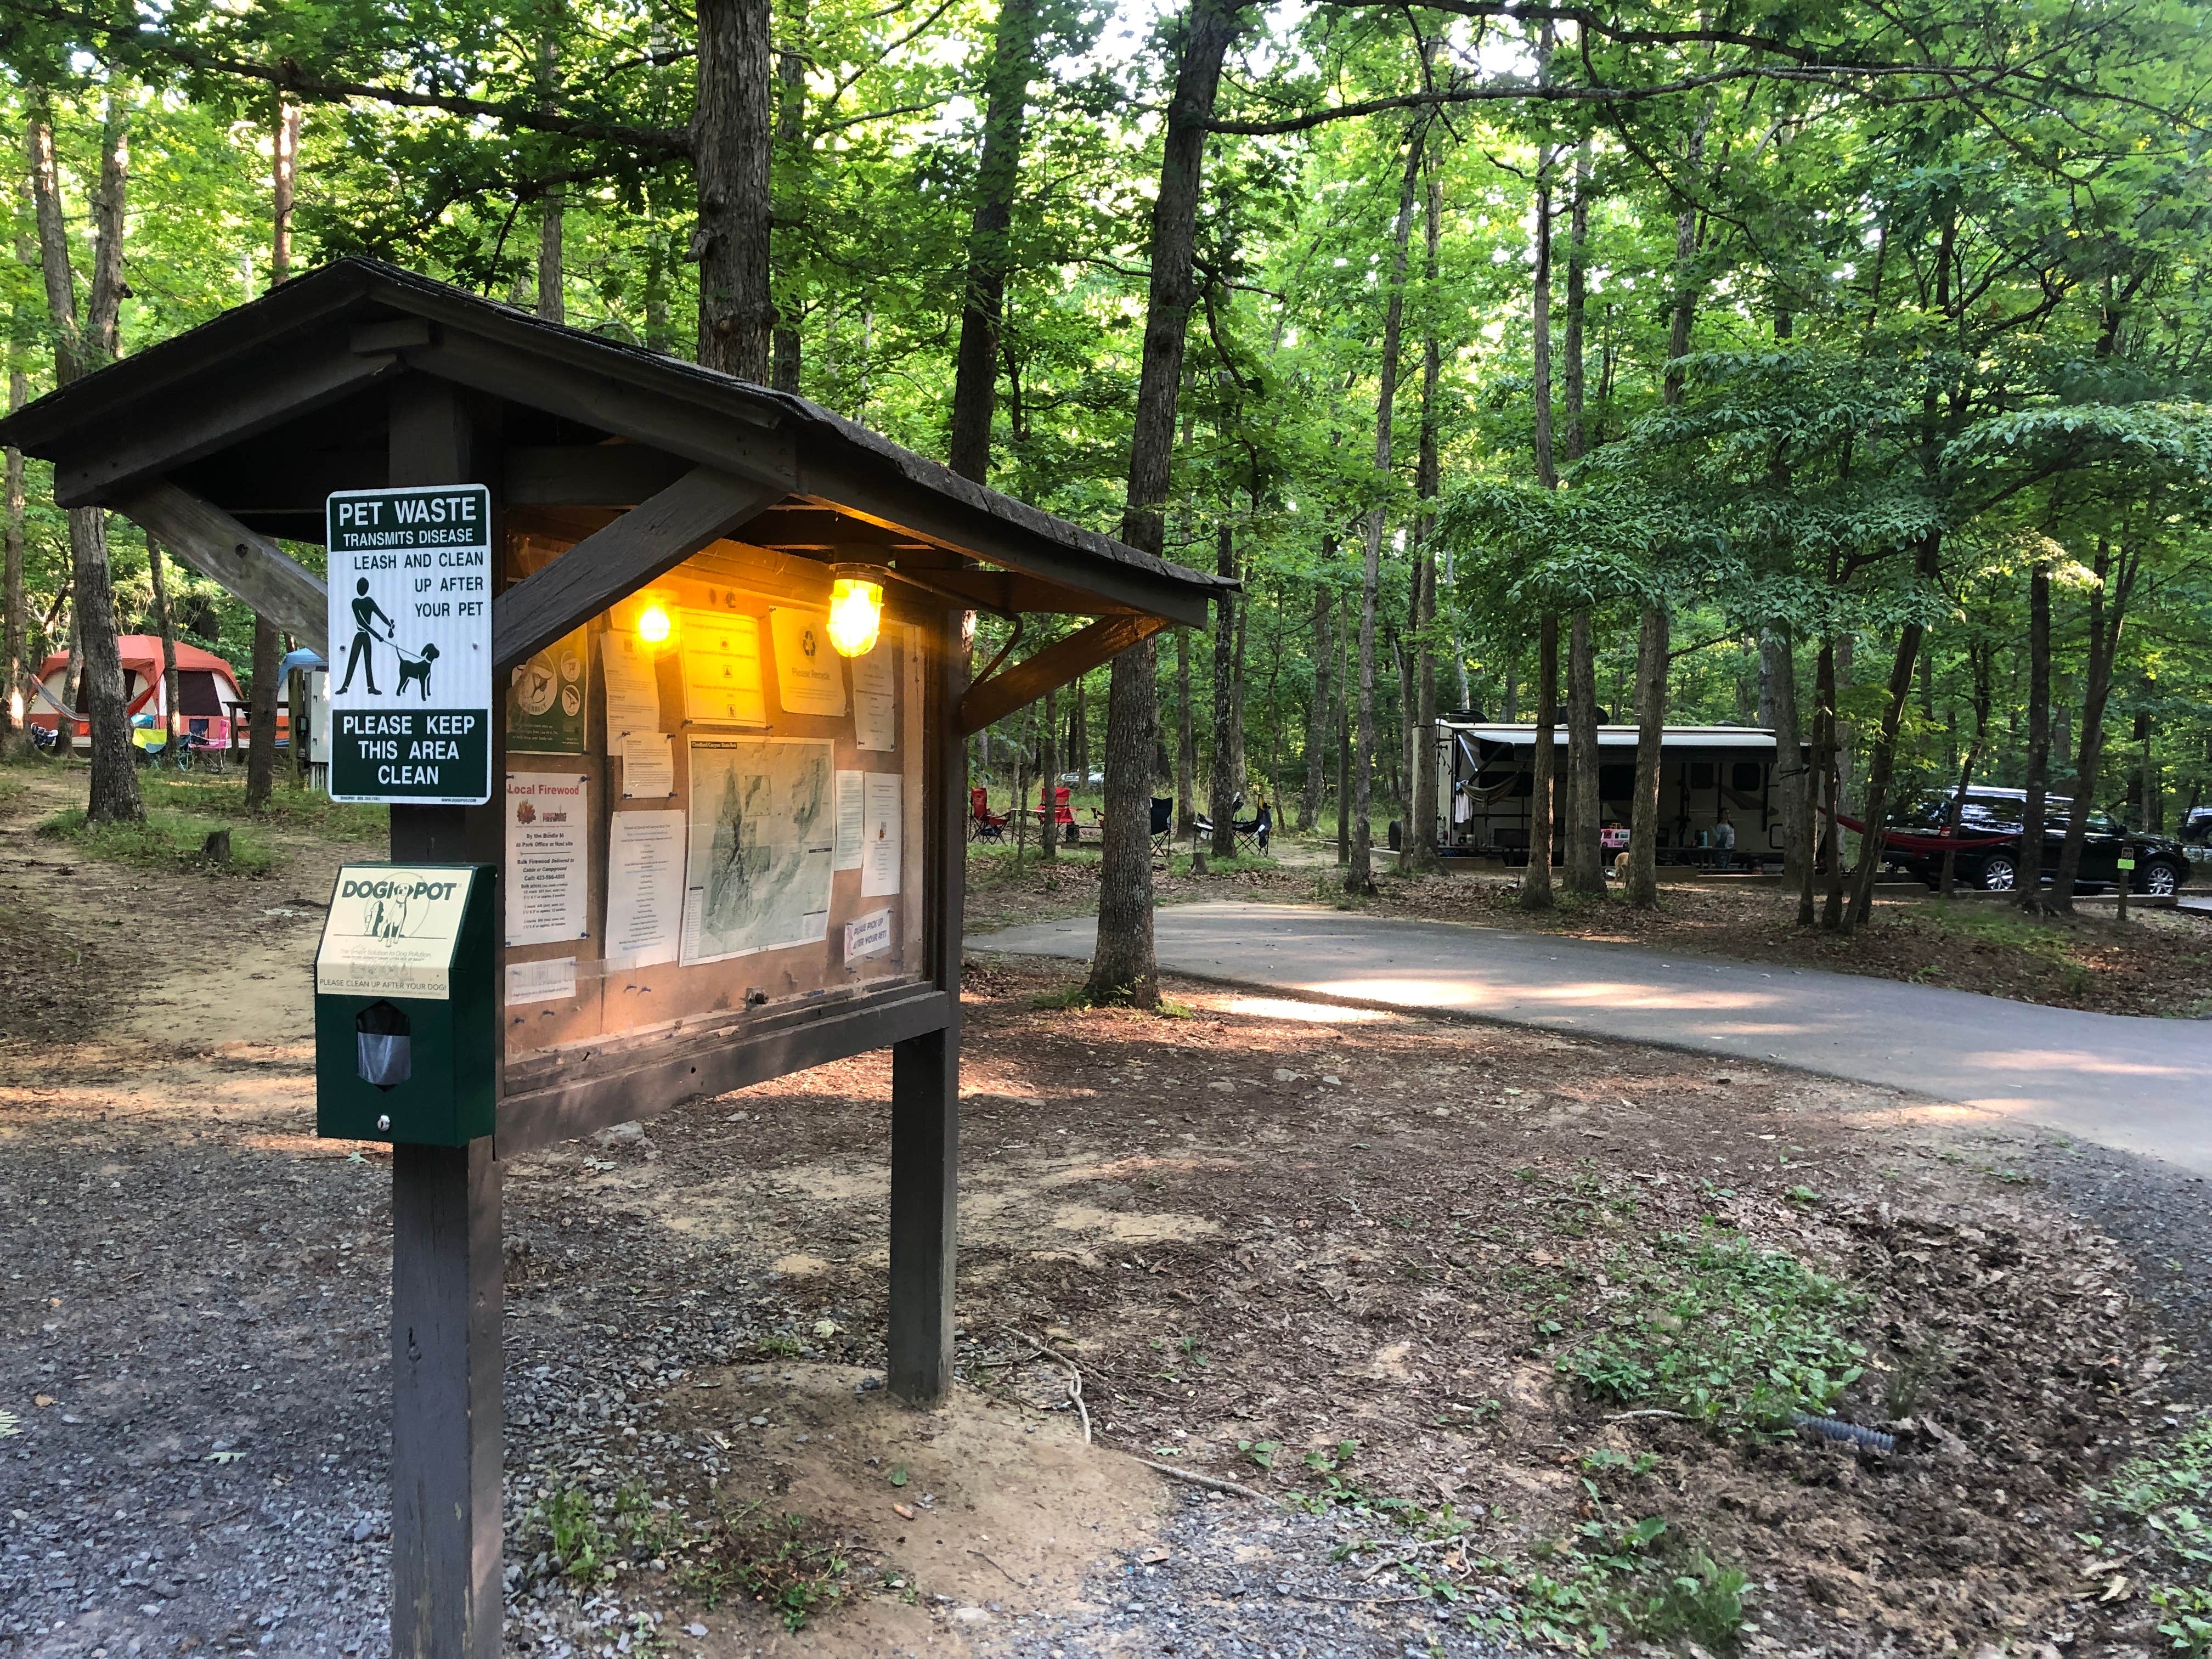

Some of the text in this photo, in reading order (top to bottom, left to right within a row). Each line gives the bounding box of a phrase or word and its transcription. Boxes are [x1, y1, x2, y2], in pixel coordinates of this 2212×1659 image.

[339, 497, 476, 526] PET WASTE
[343, 528, 473, 547] TRANSMITS DISEASE
[354, 551, 483, 569] LEASH AND CLEAN
[415, 577, 483, 592] UP AFTER
[415, 601, 483, 617] YOUR PET
[343, 715, 475, 735] PLEASE KEEP
[358, 741, 459, 760] THIS AREA
[378, 765, 439, 785] CLEAN
[507, 783, 579, 795] Local Firewood
[866, 921, 878, 930] PICK
[877, 917, 884, 927] UP
[865, 933, 878, 944] YOUR
